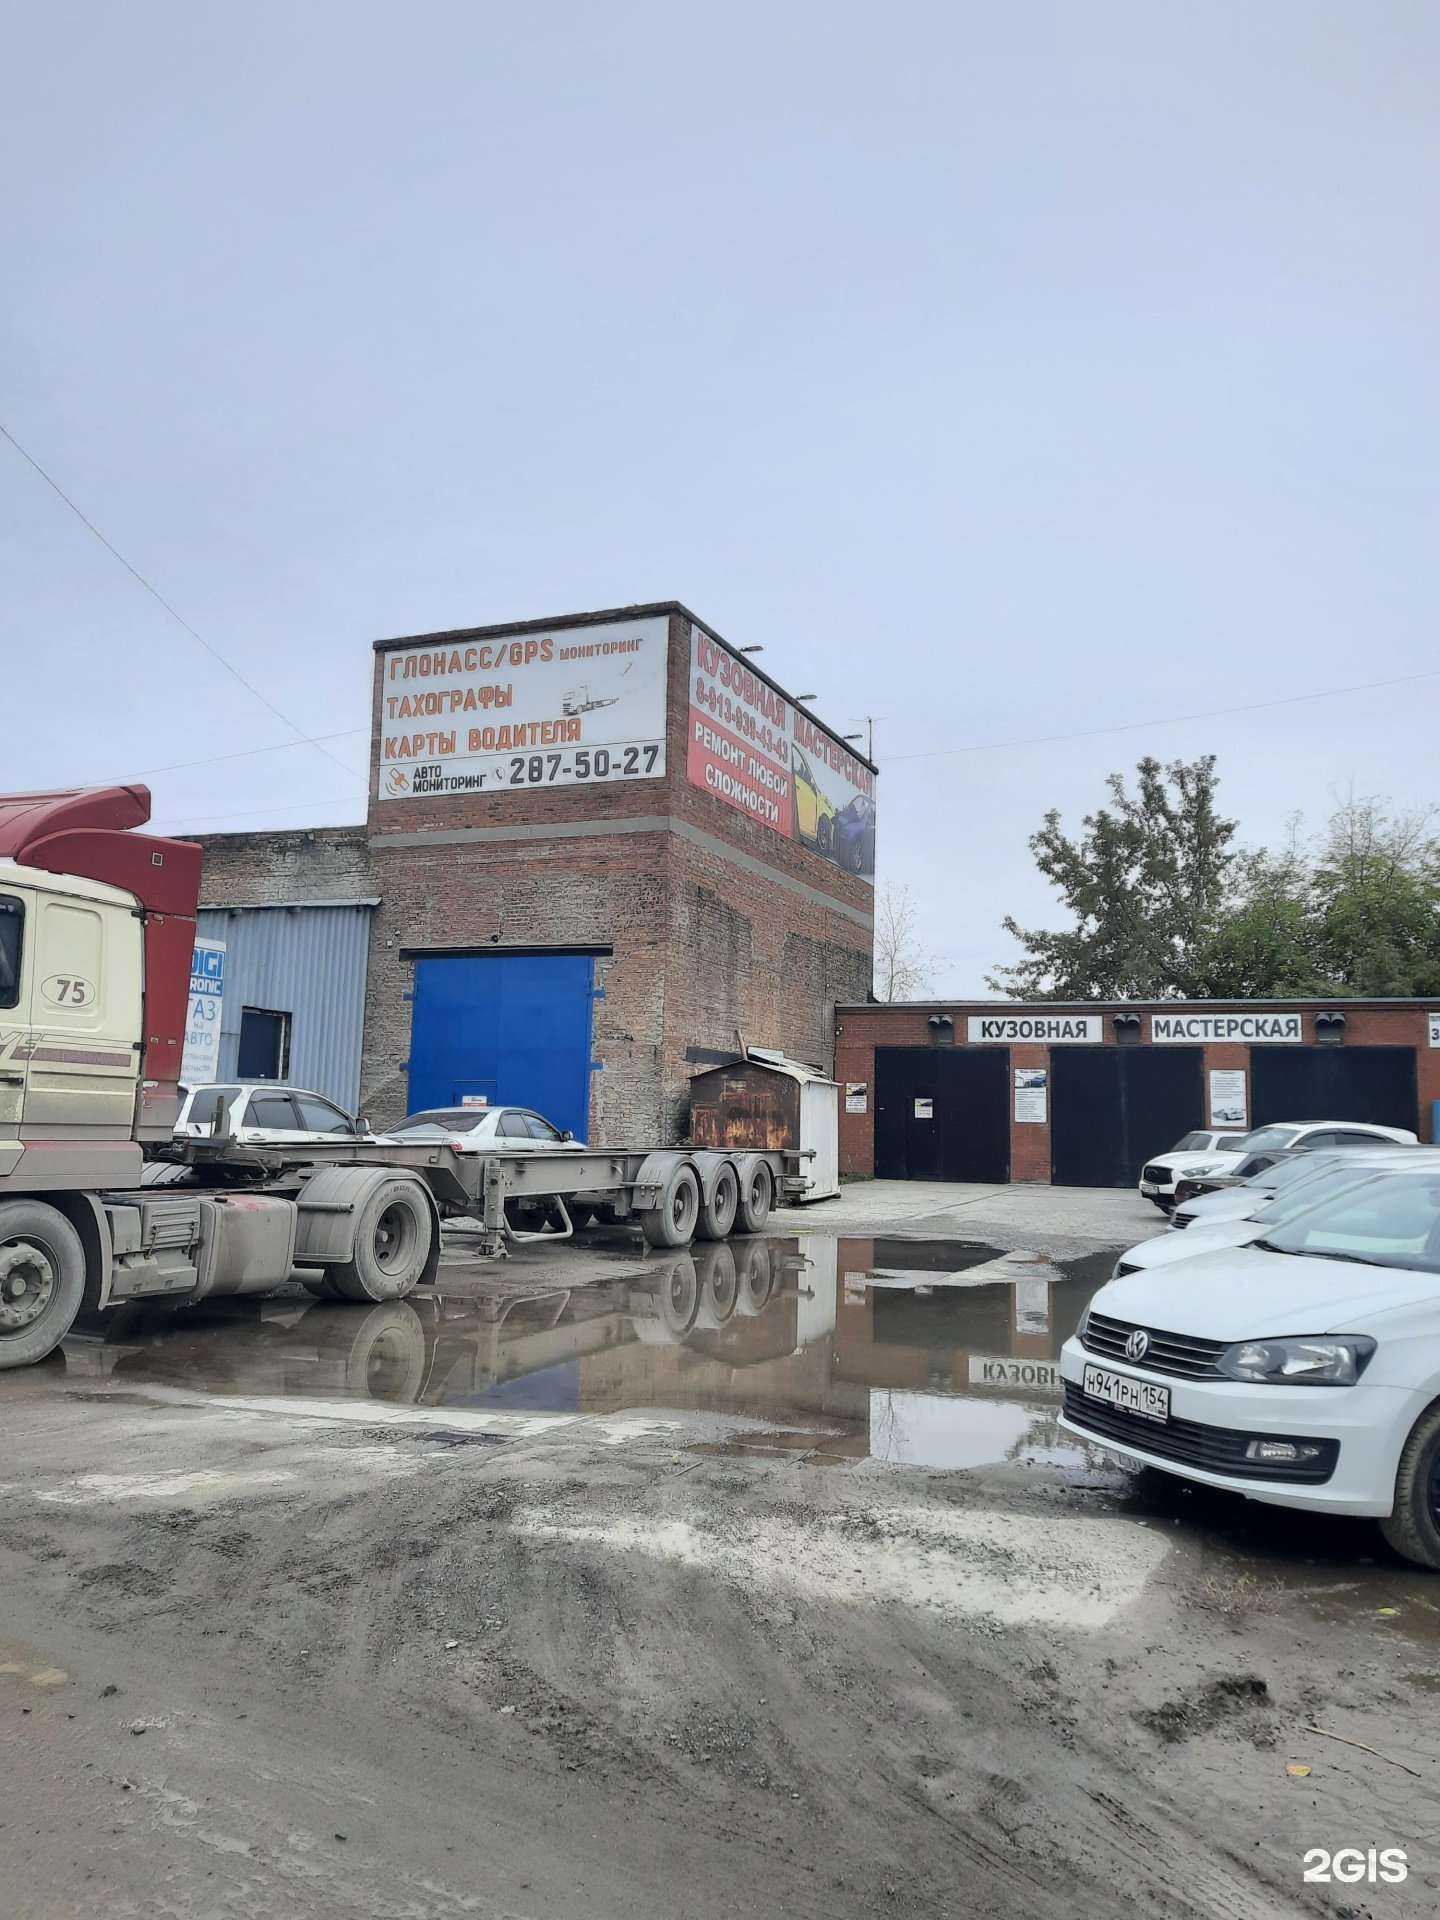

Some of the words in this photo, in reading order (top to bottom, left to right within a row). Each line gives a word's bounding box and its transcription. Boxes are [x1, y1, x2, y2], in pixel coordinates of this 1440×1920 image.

[390, 639, 554, 681] ГЛОНАСС/GPS
[386, 684, 513, 719] ТАХОГРАФЫ
[697, 632, 786, 731] КУЗОВНАЯ
[793, 711, 873, 797] МАСТЕРСКАЯ
[384, 730, 456, 759] КАРТЫ
[468, 718, 582, 751] ВОДИТЕЛЯ
[413, 764, 442, 780] АВТО
[510, 745, 659, 784] 287-50-27
[695, 720, 746, 770] РЕМОНТ
[747, 756, 788, 798] ЛЮБОЙ
[412, 773, 487, 793] МОНИТОРИНГ
[705, 763, 780, 824] СЛОЖНОСТИ
[56, 979, 85, 1003] 75
[189, 997, 216, 1021] АЗ
[981, 1020, 1088, 1040] КУЗОВНАЯ
[1154, 1017, 1299, 1038] МАСТЕРСКАЯ
[1143, 1385, 1165, 1408] 154
